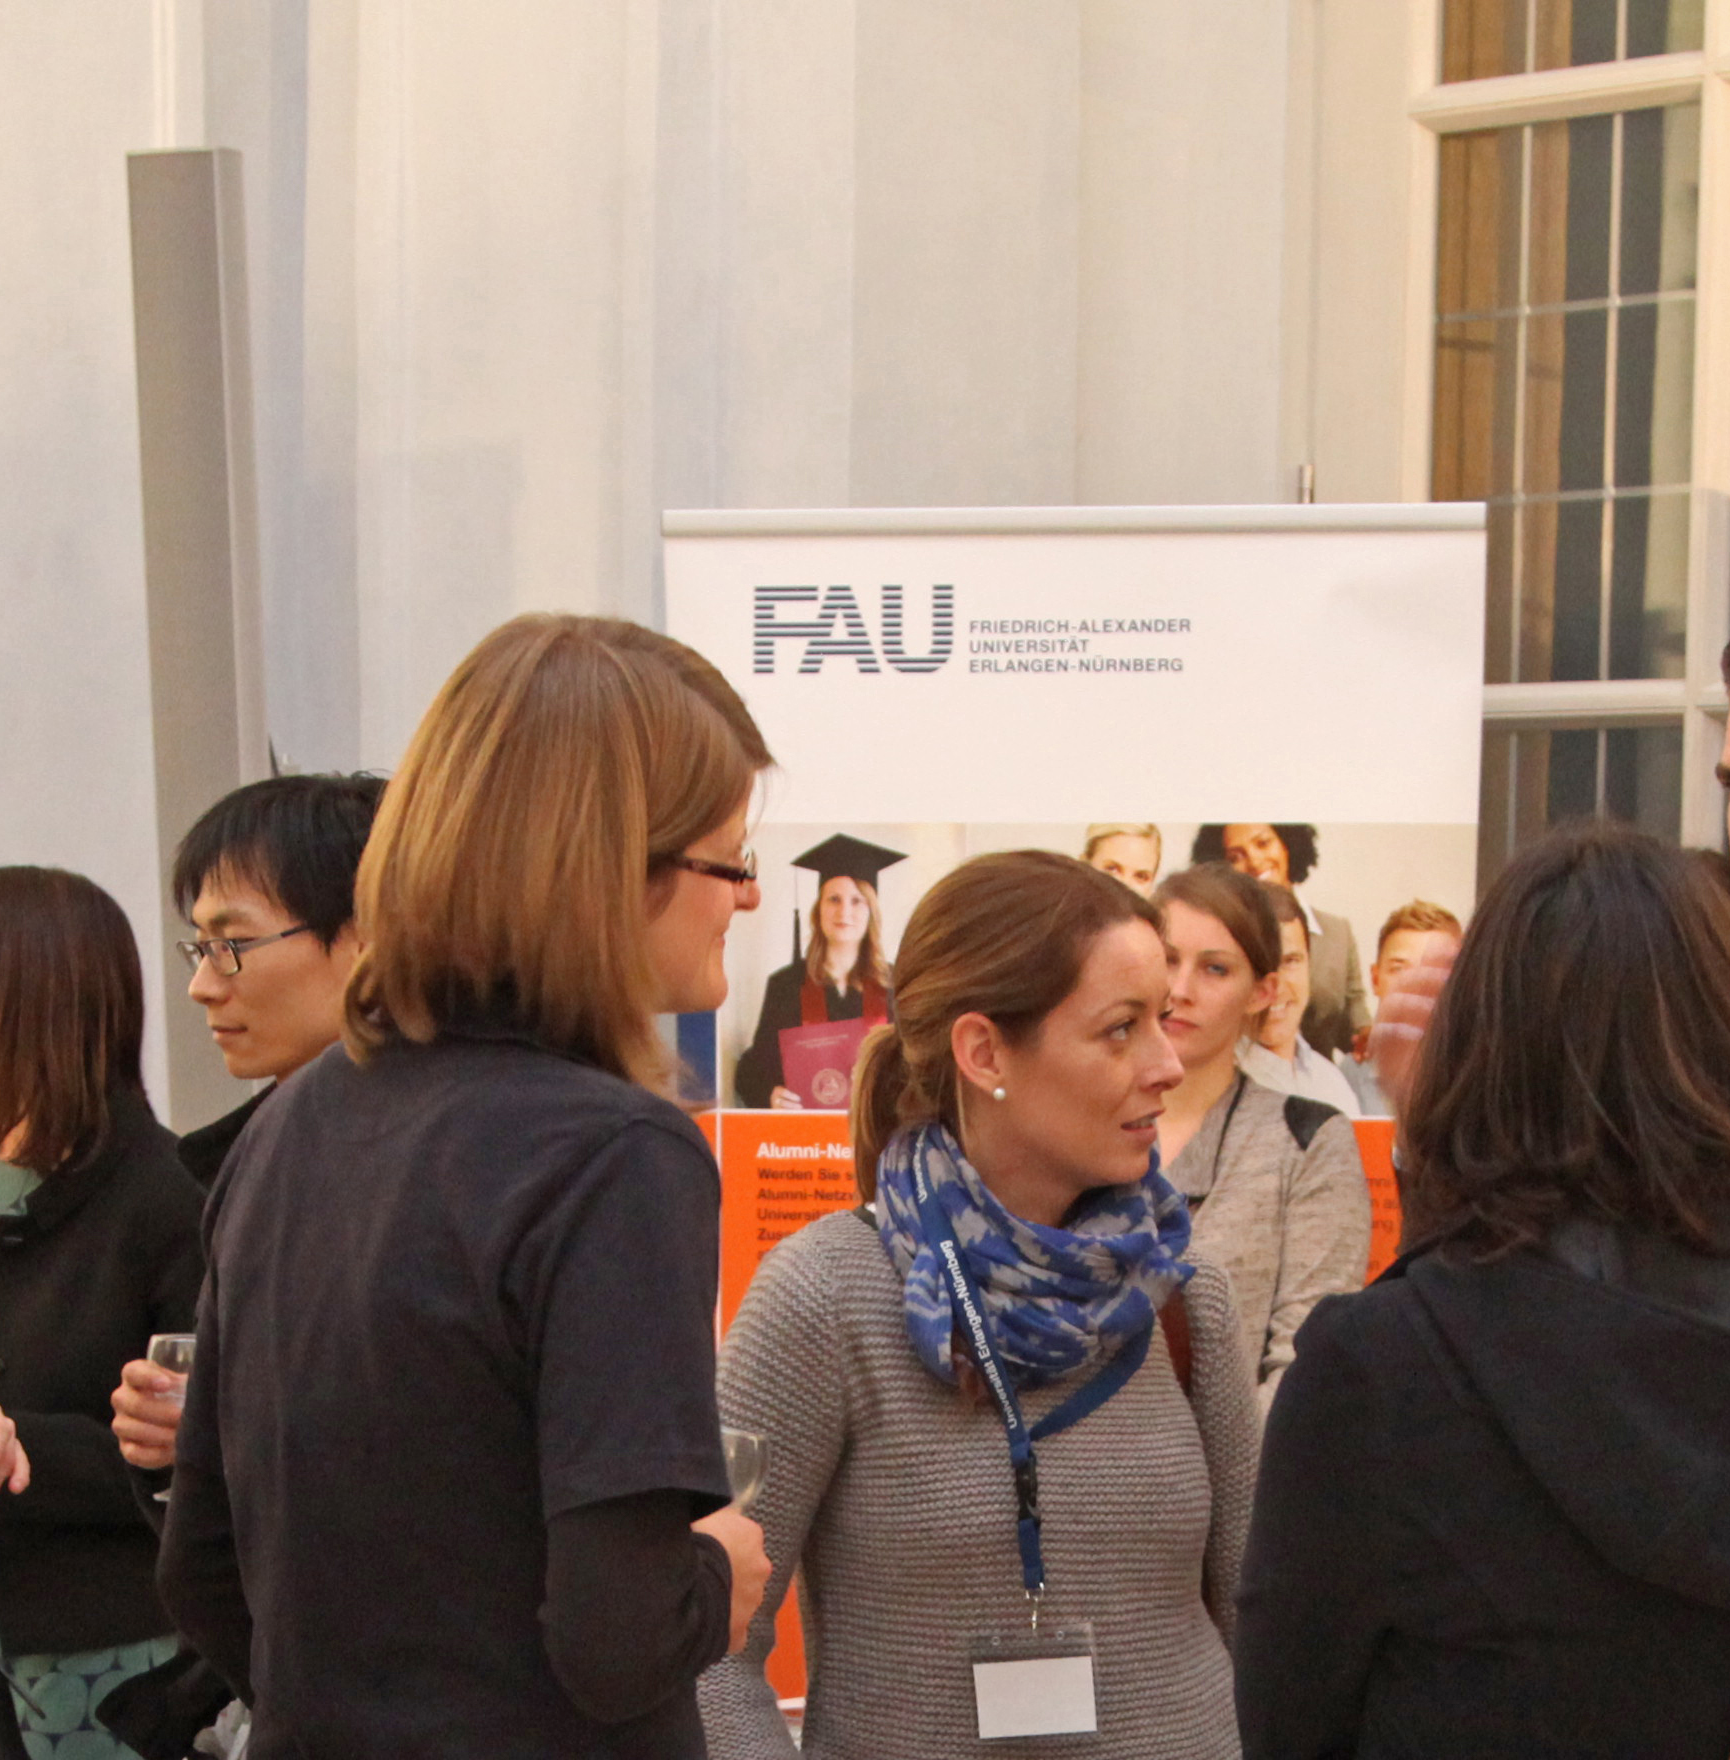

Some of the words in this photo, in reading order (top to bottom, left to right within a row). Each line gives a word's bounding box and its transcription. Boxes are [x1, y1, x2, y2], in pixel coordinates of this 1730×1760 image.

[753, 584, 955, 674] FAU
[968, 618, 1192, 634] FRIEDRICH-ALEXANDER
[968, 636, 1090, 654] UNIVERSITÄT
[968, 655, 1184, 673] ERLANGEN-NÜRNBERG
[757, 1168, 813, 1180] Werden
[818, 1168, 840, 1180] Sie
[939, 1239, 992, 1361] Erlangen-Nürnberg
[982, 1358, 1018, 1431] Universität
